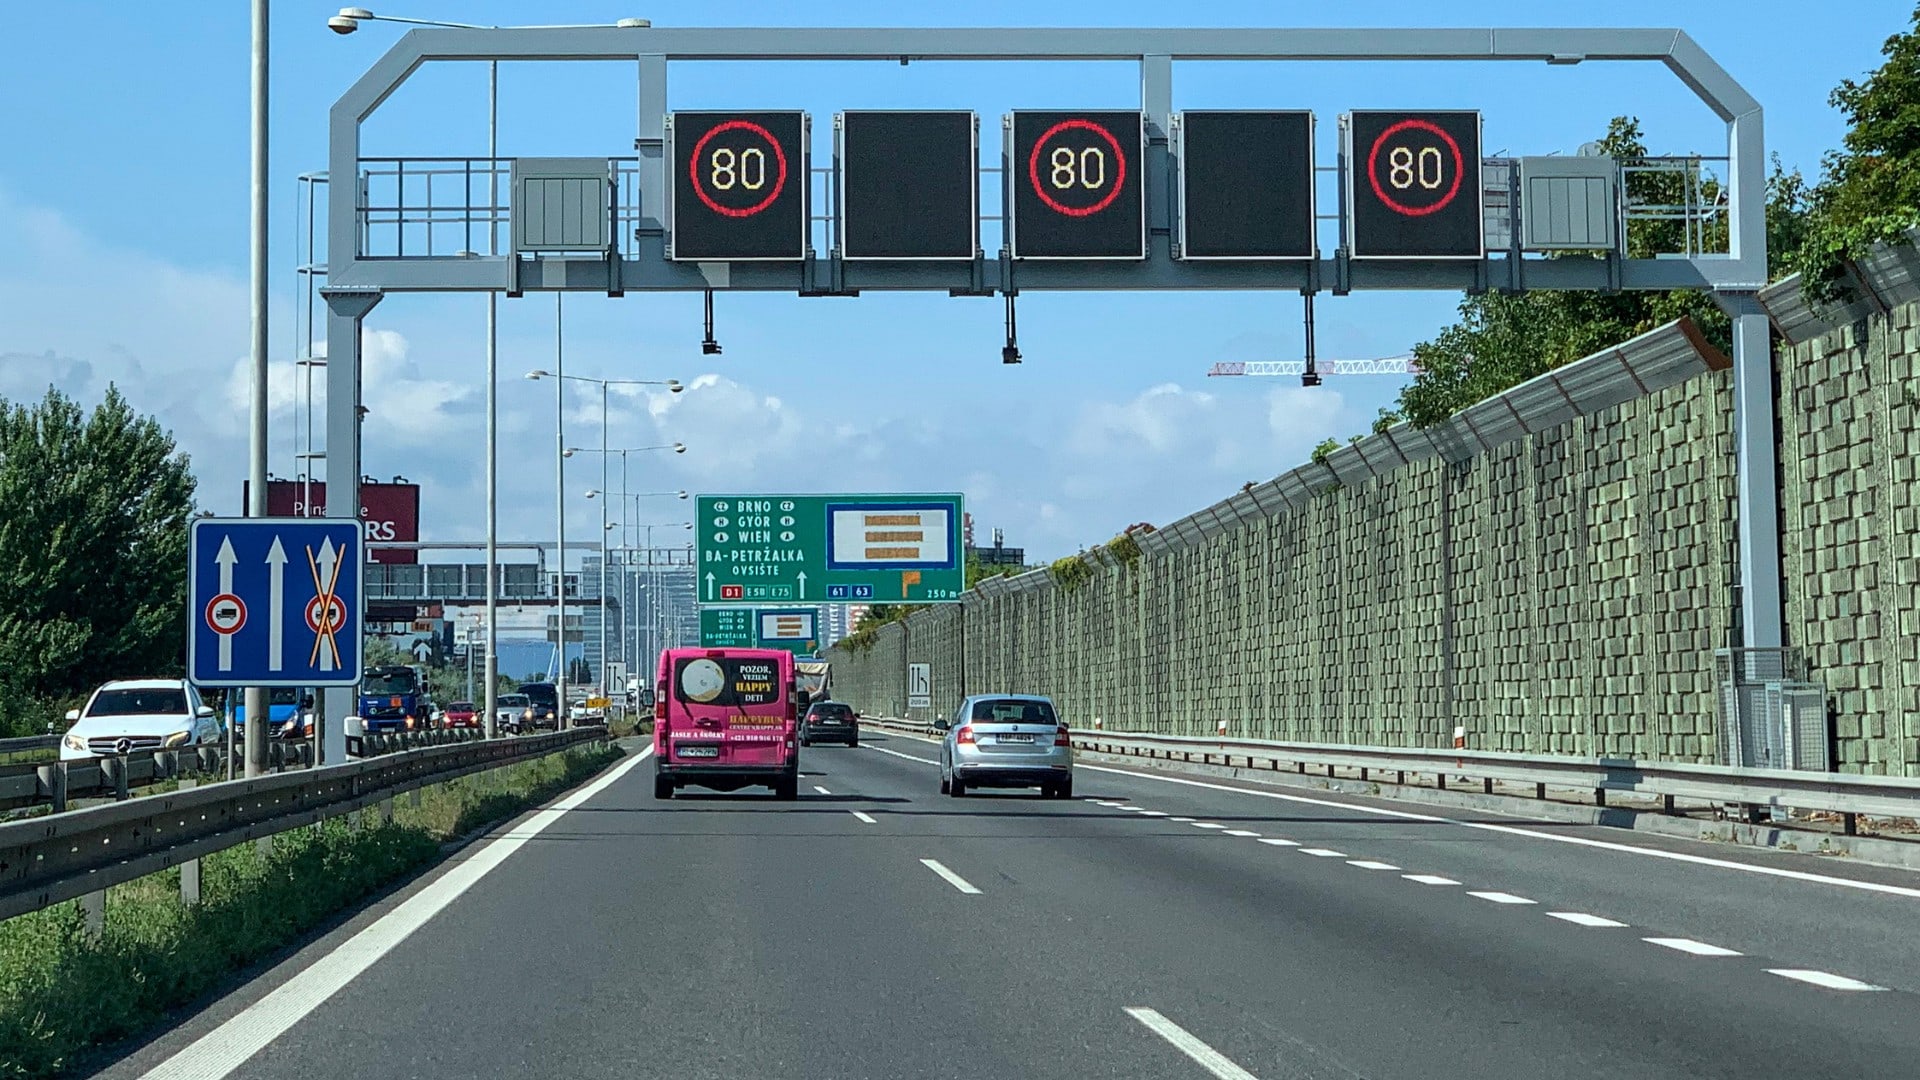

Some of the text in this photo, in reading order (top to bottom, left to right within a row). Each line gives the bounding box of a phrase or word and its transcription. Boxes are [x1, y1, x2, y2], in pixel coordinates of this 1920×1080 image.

[711, 147, 766, 190] 80
[1050, 147, 1105, 190] 80
[1389, 146, 1443, 189] 80
[737, 501, 771, 512] BRNO
[738, 531, 771, 544] WIEN
[705, 547, 804, 562] BA-PETRŽALKA
[732, 564, 779, 576] OVSIŠTE
[832, 588, 844, 597] 61
[856, 588, 869, 597] 63
[927, 590, 946, 598] 250
[740, 665, 772, 674] POZOR,
[736, 682, 772, 692] HAPPY
[745, 694, 764, 702] DETI
